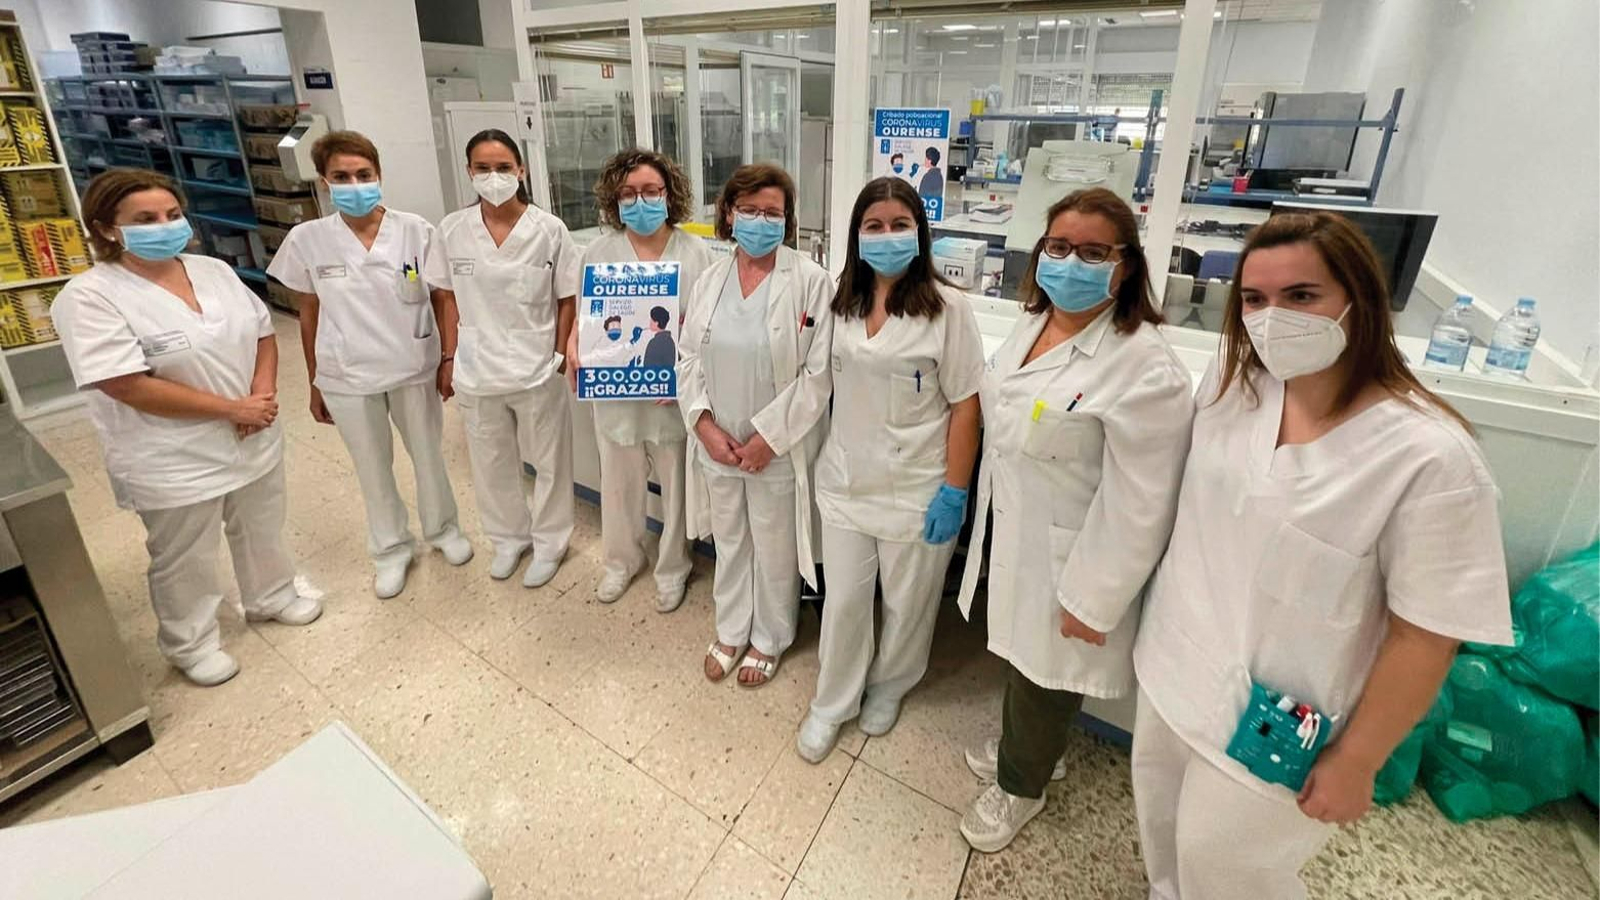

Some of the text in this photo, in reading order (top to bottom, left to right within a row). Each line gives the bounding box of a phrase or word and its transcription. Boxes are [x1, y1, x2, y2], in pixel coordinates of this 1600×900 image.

[882, 119, 942, 127] CORONAVIRUS
[882, 127, 940, 137] OURENSE
[593, 275, 670, 285] CORONAVIRUS
[593, 284, 668, 295] OURENSE
[585, 370, 670, 383] 300.000
[585, 384, 668, 397] ¡¡GRAZAS!!
